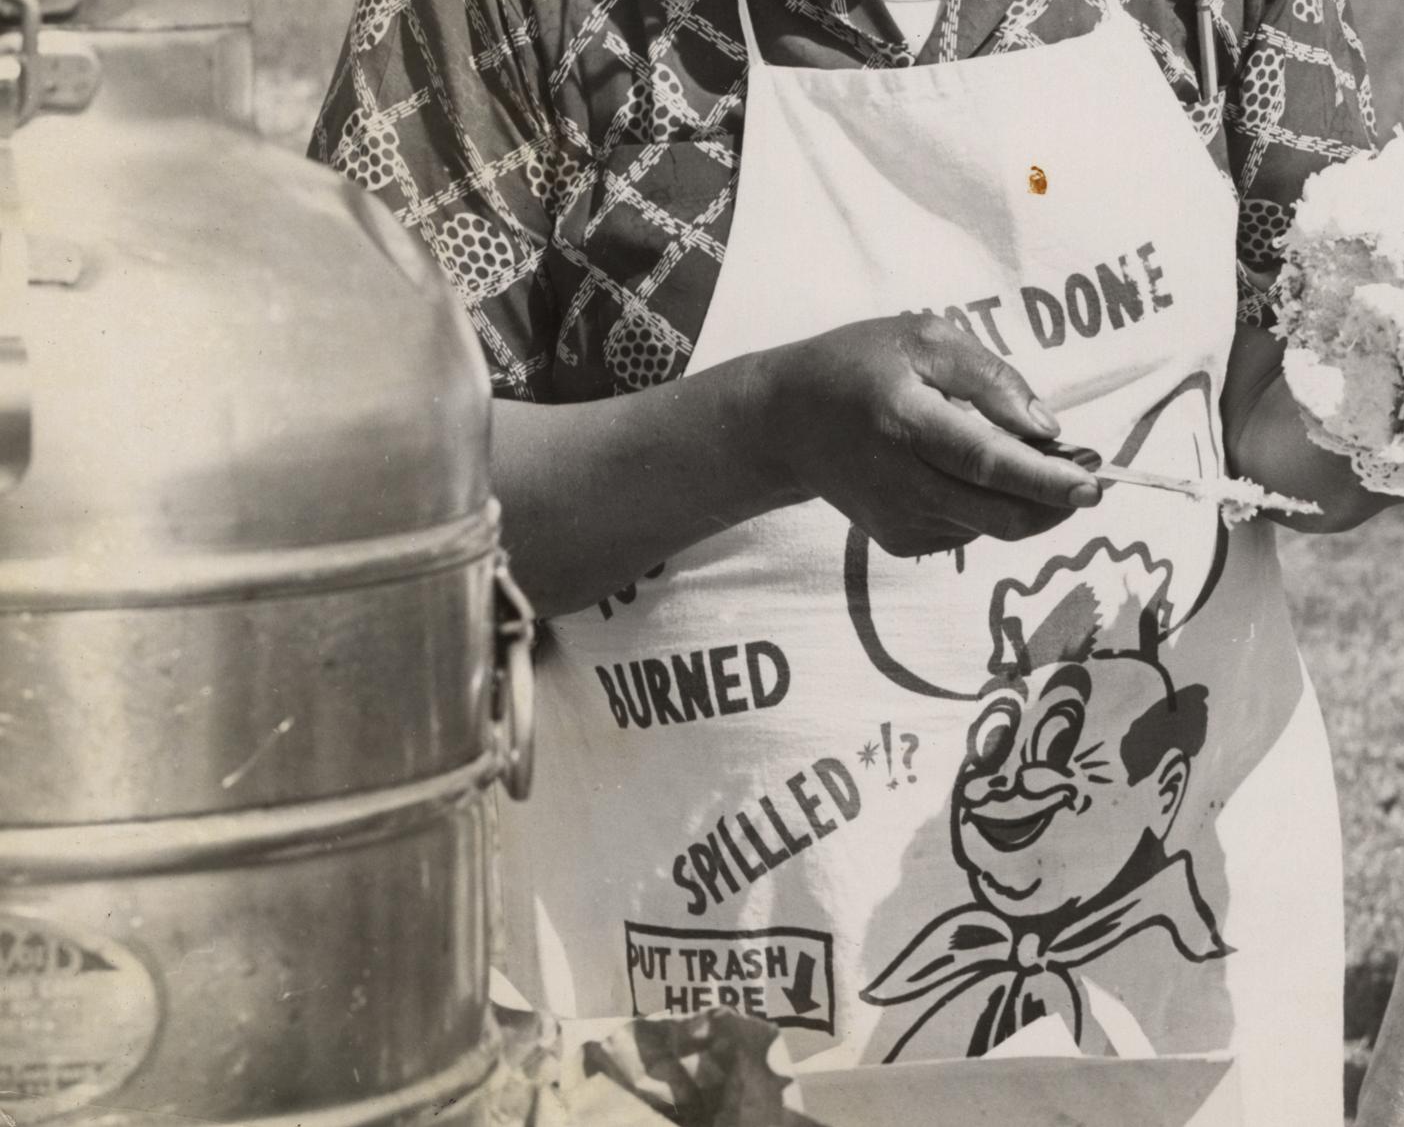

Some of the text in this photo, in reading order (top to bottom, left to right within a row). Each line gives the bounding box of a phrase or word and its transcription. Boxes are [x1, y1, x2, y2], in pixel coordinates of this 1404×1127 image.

[1020, 241, 1174, 350] DONE
[595, 640, 791, 728] BURNED
[627, 941, 789, 982] PUT TRASH
[665, 985, 767, 1018] HERE
